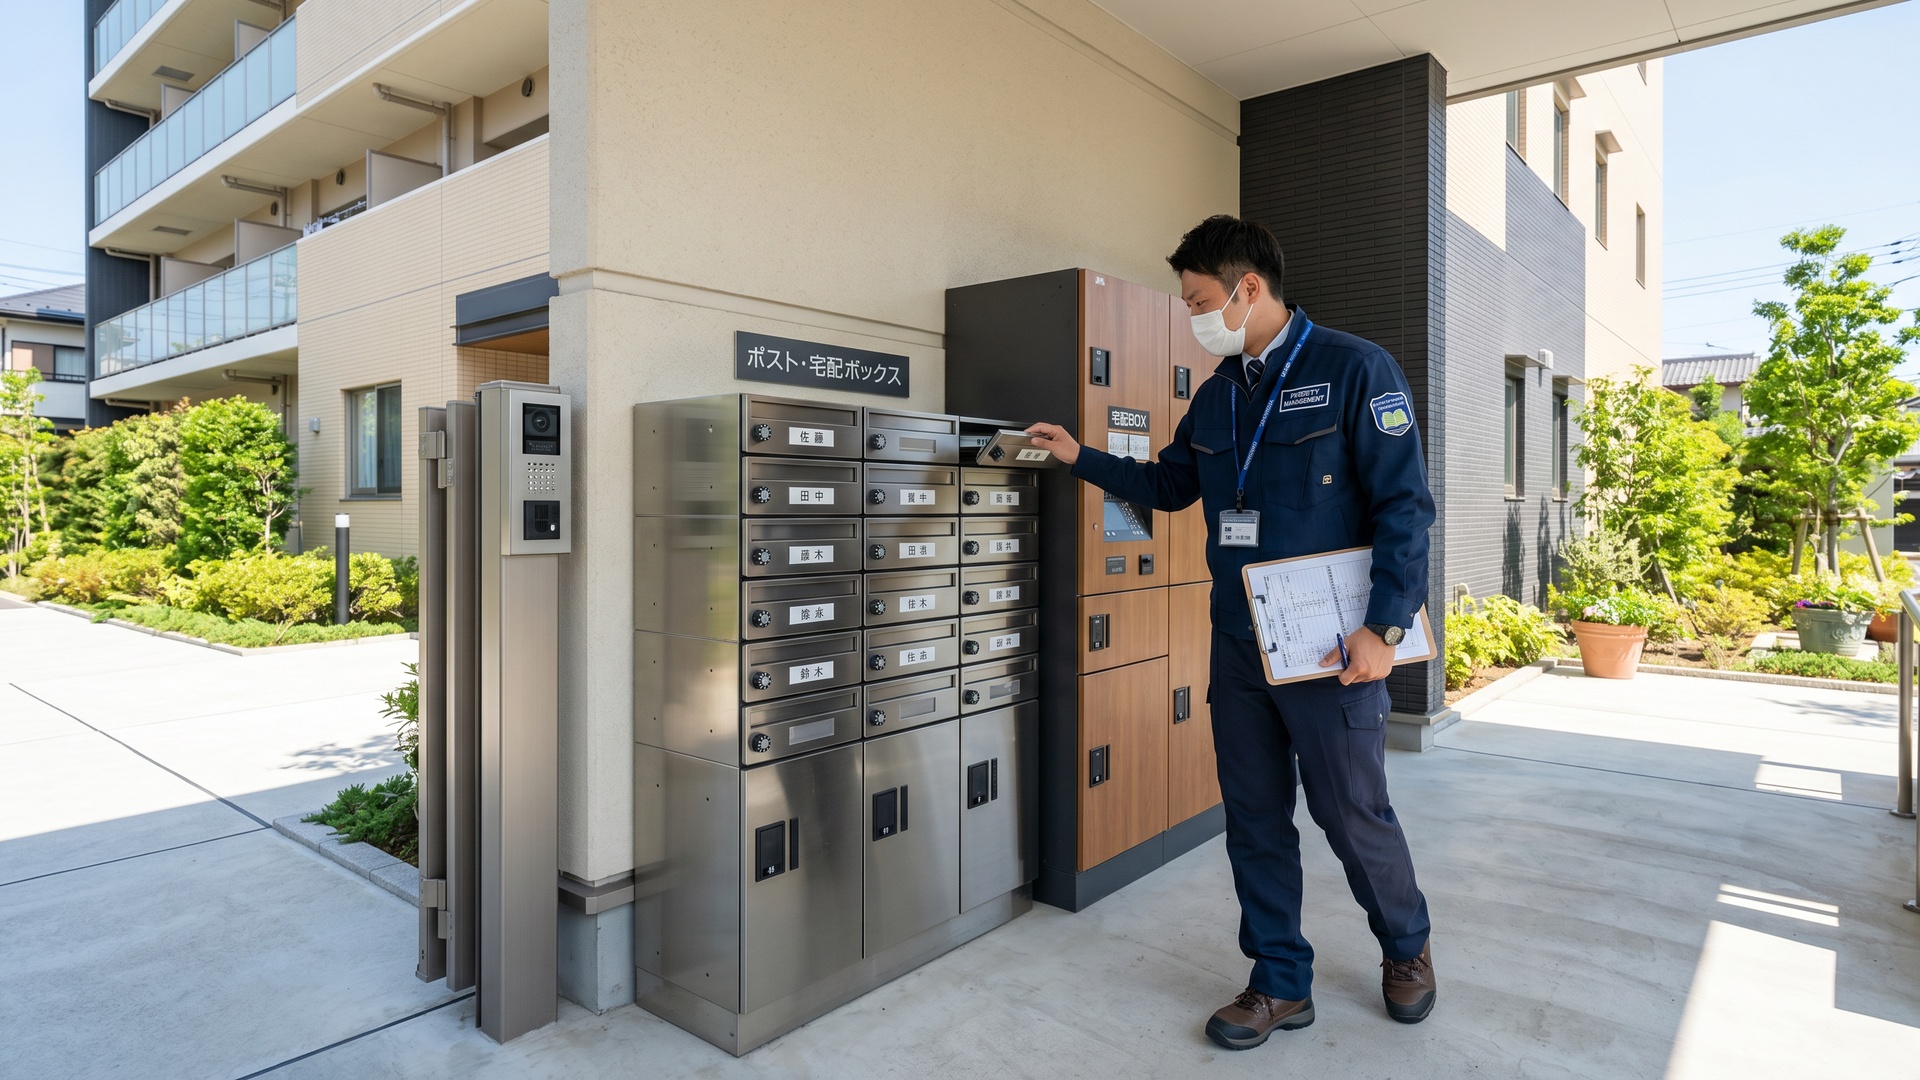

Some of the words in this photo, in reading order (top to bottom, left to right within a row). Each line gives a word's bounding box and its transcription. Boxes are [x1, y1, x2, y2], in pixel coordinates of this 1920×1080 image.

[747, 346, 902, 386] ポスト・宅配ボックス
[1111, 410, 1147, 428] 宅配BOX
[800, 490, 824, 502] 田中
